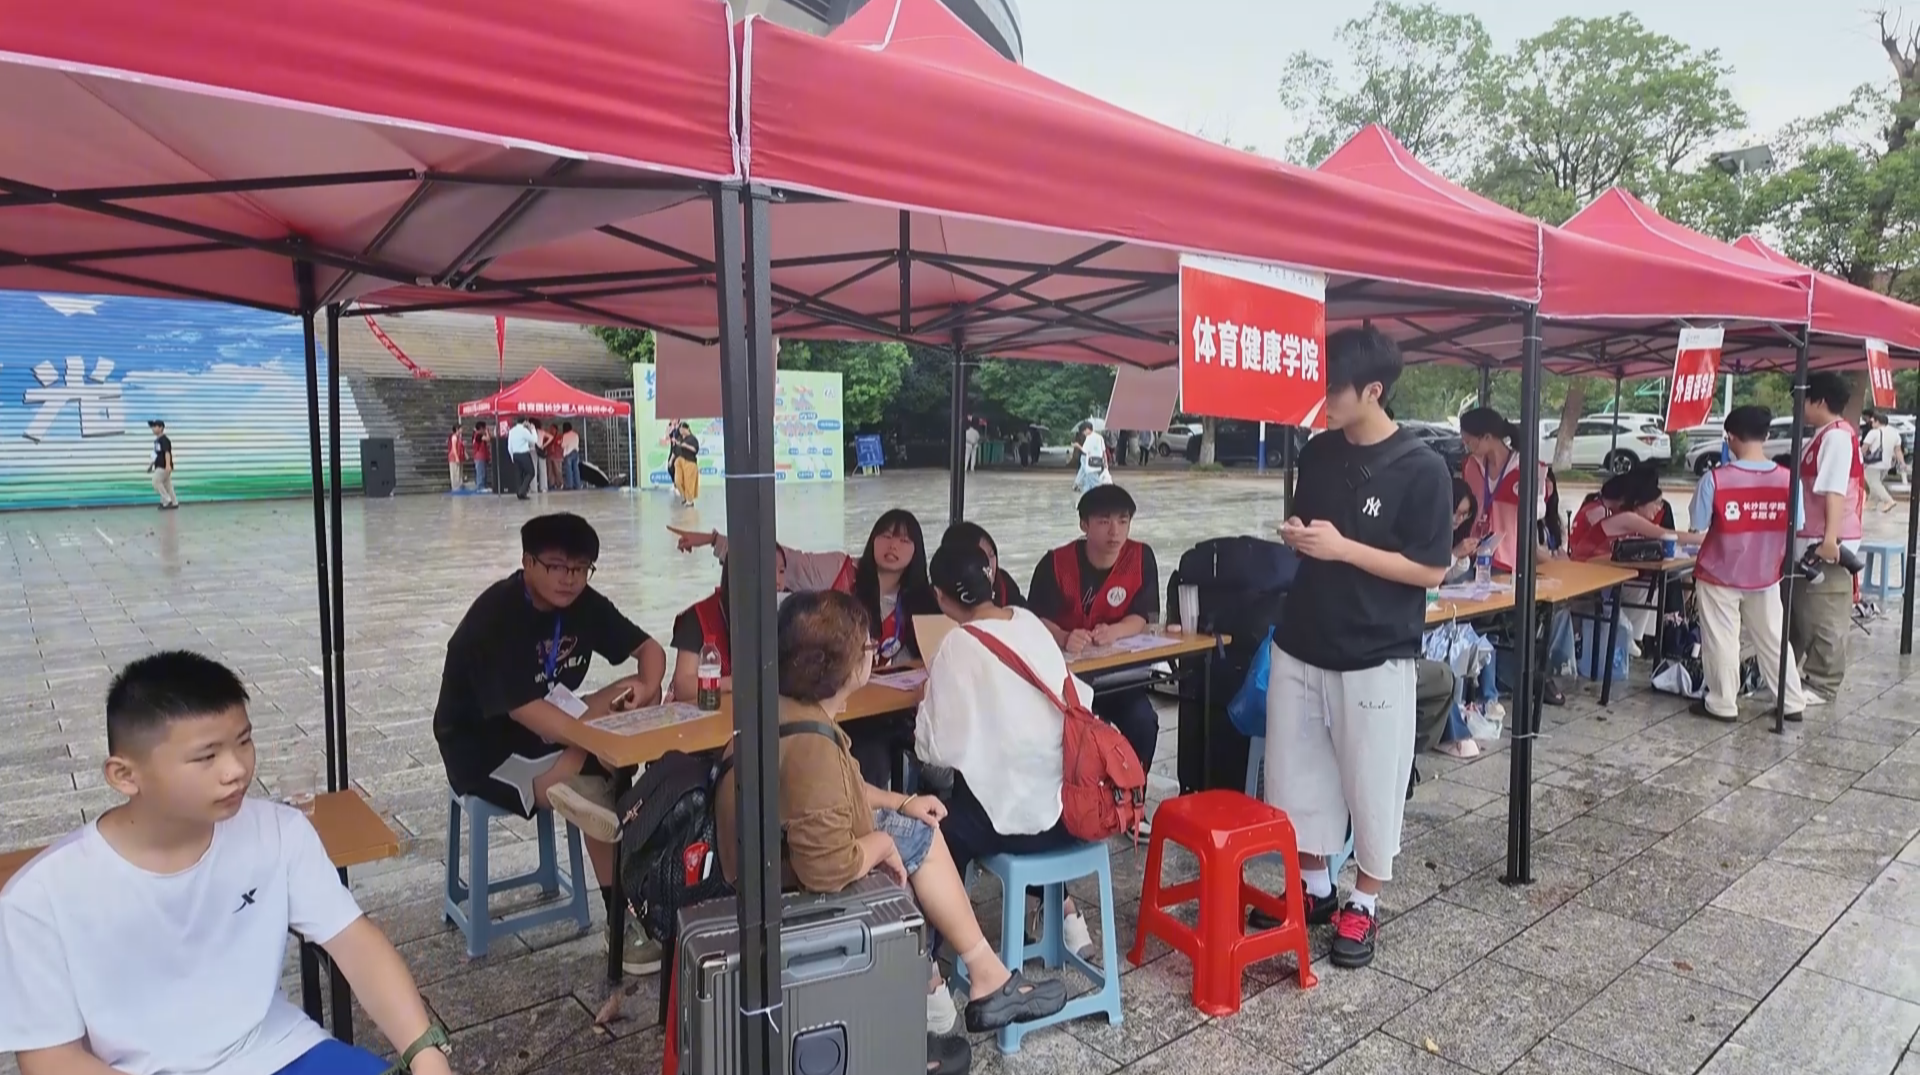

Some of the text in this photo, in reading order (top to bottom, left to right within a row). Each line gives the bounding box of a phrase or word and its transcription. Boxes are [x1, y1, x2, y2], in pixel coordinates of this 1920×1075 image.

[1192, 314, 1319, 382] 体育健康学院
[22, 355, 126, 444] 光
[1674, 372, 1715, 404] 外国语学院
[1742, 501, 1787, 511] 长沙医学院
